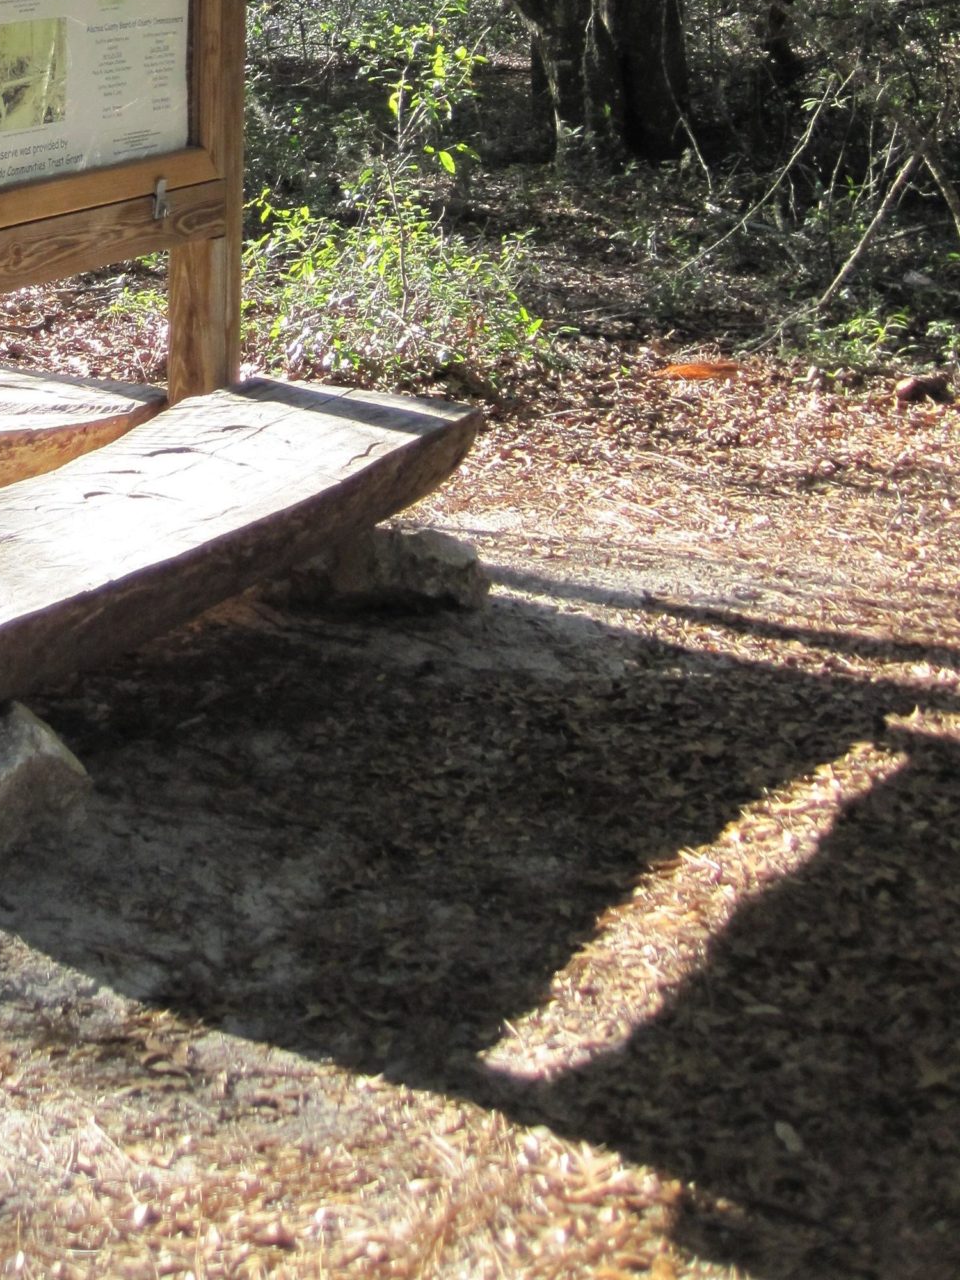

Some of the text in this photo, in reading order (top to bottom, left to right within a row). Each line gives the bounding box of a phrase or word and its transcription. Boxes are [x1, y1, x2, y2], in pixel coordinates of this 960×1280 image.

[19, 146, 31, 156] was
[32, 140, 59, 156] provided
[60, 139, 69, 150] by
[7, 160, 46, 177] Communities
[48, 157, 64, 167] Trust
